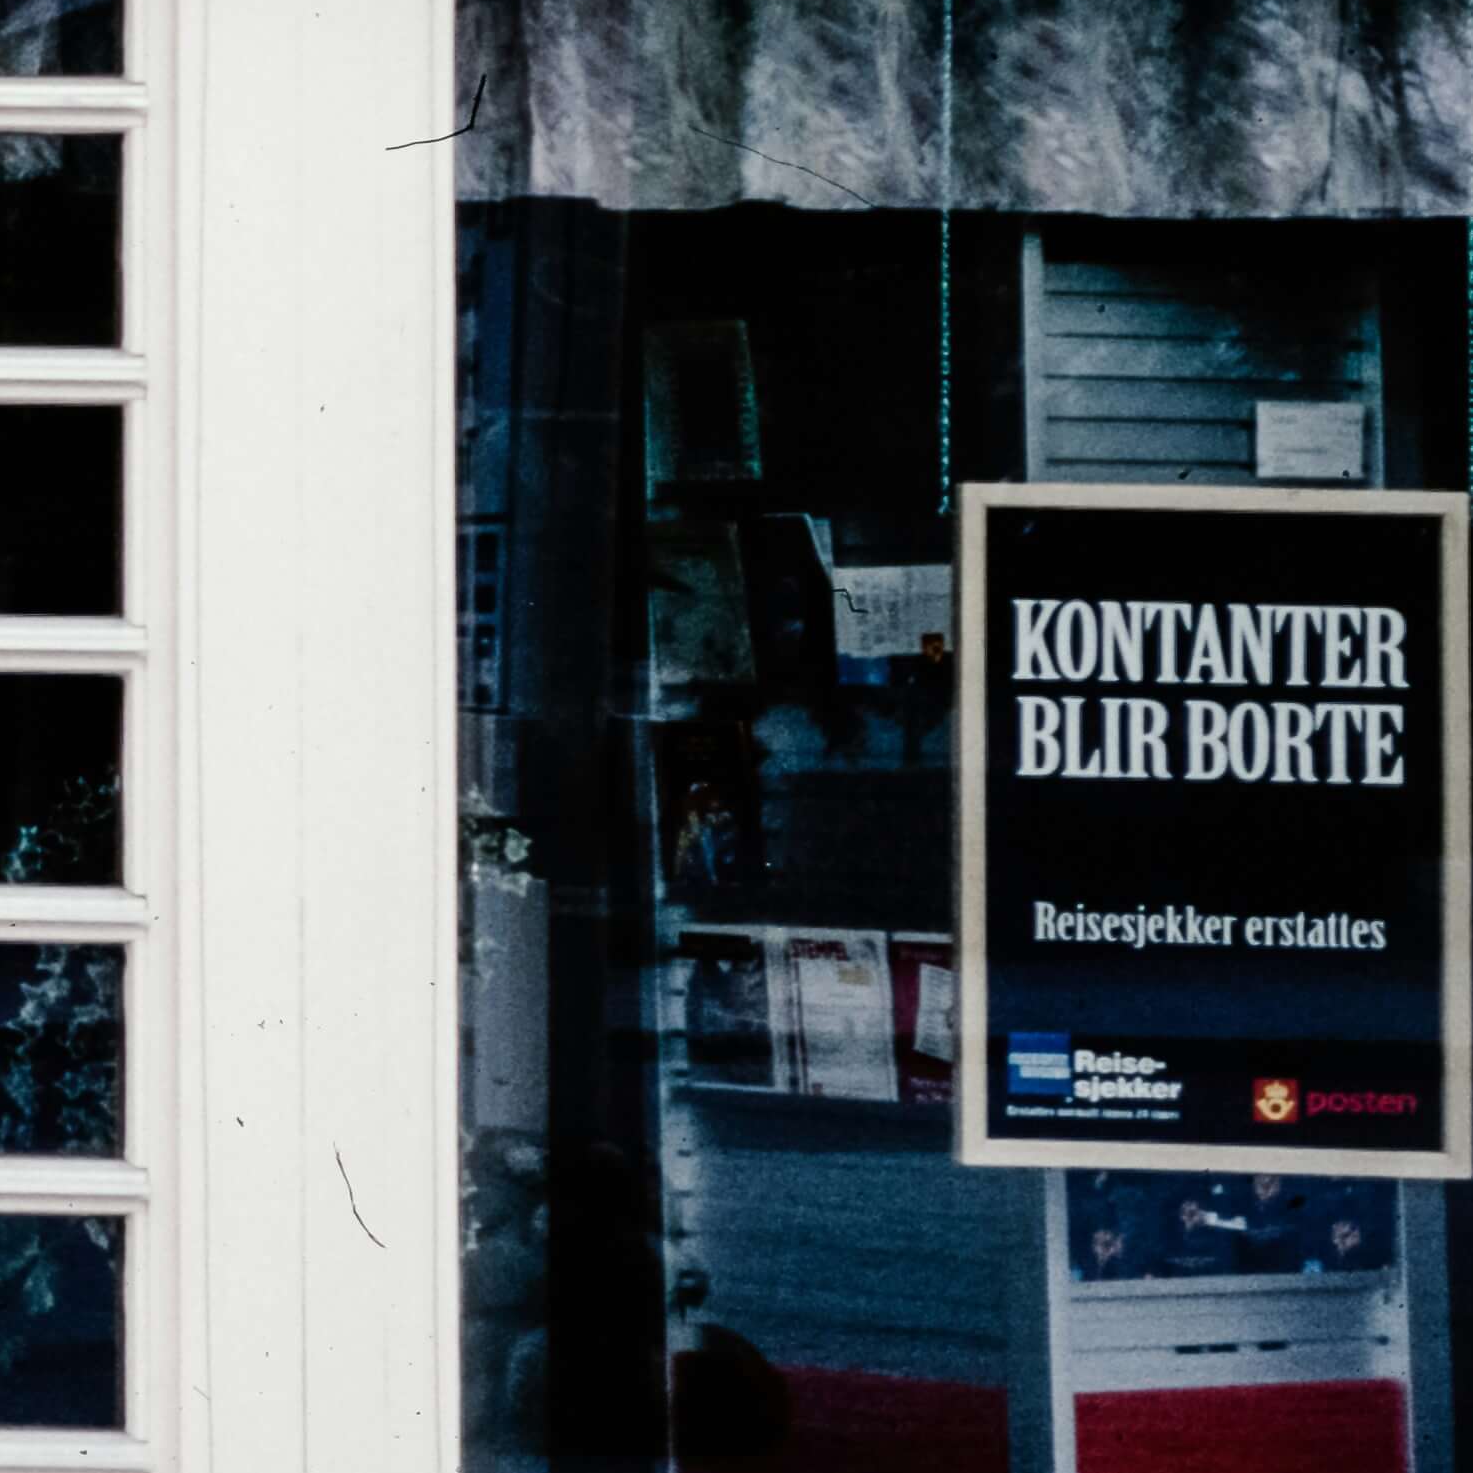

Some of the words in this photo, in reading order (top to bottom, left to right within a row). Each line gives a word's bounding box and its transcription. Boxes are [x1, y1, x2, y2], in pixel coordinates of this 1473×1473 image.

[1012, 597, 1410, 689] KONTANTER
[1016, 694, 1173, 780] BLIR
[1183, 698, 1405, 786] BORTE
[1033, 901, 1238, 949] Reisesjekker
[1243, 910, 1387, 950] erstattes
[1073, 1049, 1167, 1075] Reise-
[1073, 1075, 1182, 1104] sjekker
[1305, 1090, 1418, 1117] posten
